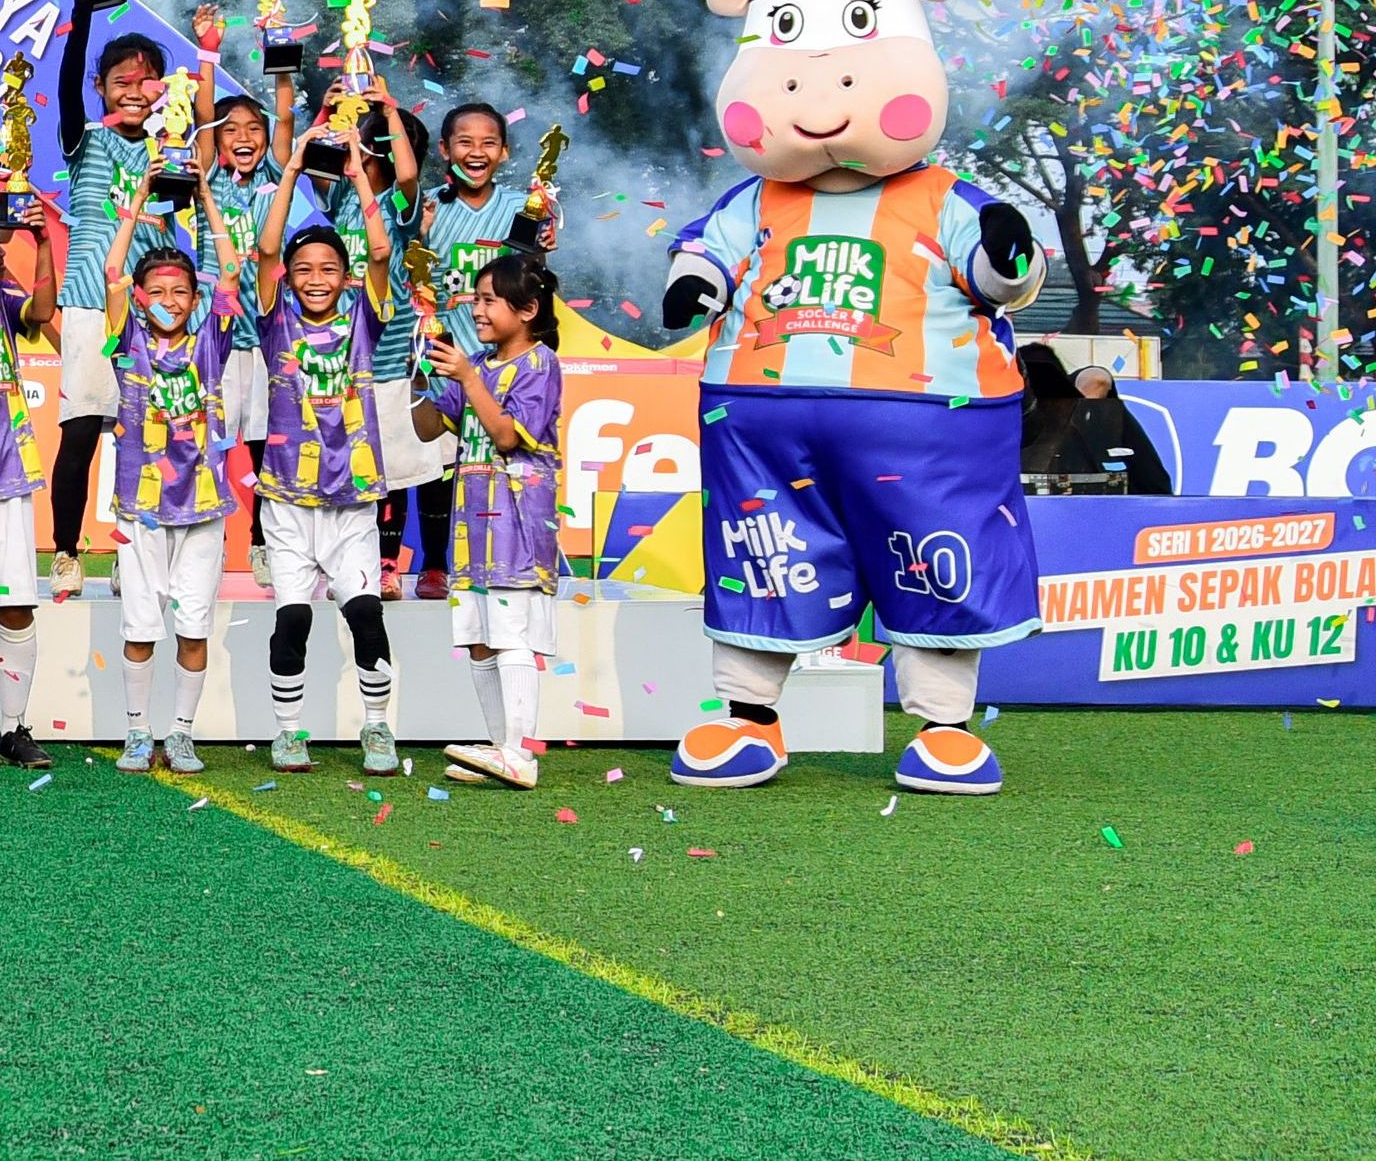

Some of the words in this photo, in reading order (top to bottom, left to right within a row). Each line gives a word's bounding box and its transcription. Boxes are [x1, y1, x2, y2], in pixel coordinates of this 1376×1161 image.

[793, 241, 874, 280] Milk
[799, 274, 875, 310] Life
[786, 320, 859, 333] CHALLENGE
[722, 512, 806, 558] Milk
[1147, 528, 1191, 558] SERI
[1196, 527, 1206, 553] 1
[1213, 519, 1327, 552] 2026-2027
[742, 555, 820, 598] Life
[888, 530, 972, 603] 10
[1039, 574, 1167, 624] NAMEN
[1177, 565, 1283, 614] SEPAK
[1294, 557, 1376, 604] BOLA
[1112, 627, 1158, 672] KU
[1169, 625, 1207, 668] 10
[1216, 623, 1240, 664] &
[1251, 618, 1296, 662] KU
[1307, 614, 1346, 656] 12
